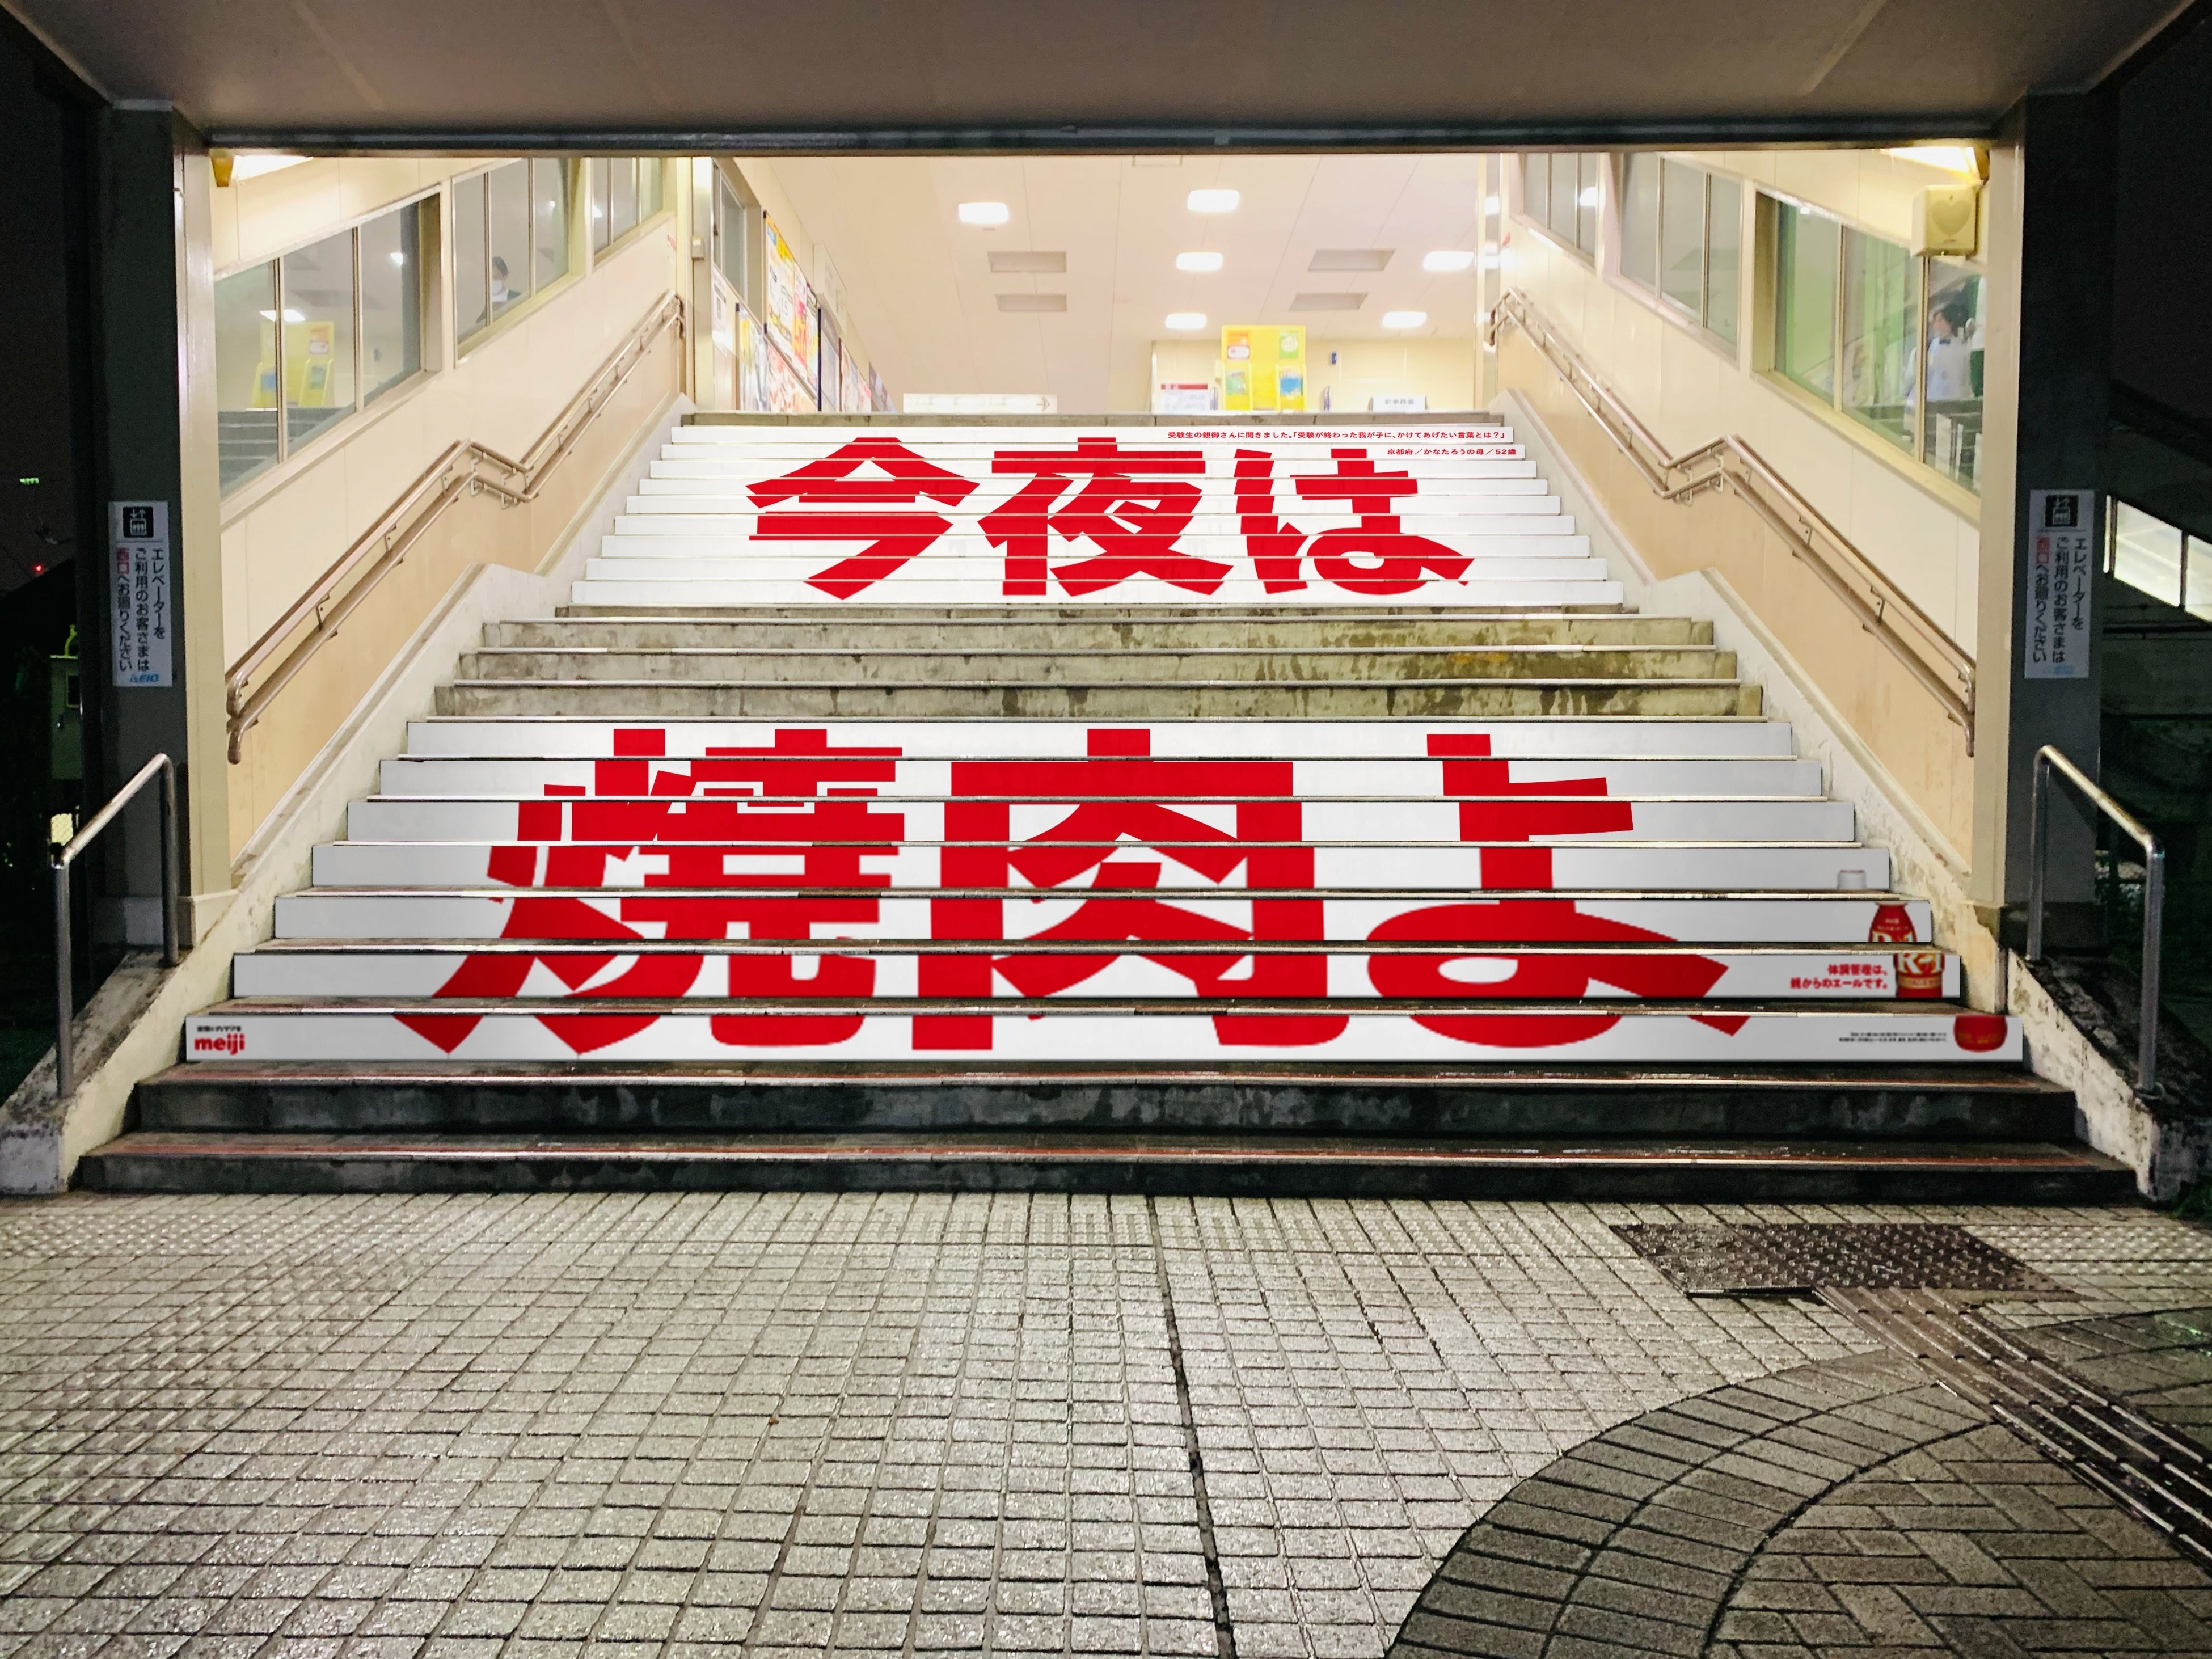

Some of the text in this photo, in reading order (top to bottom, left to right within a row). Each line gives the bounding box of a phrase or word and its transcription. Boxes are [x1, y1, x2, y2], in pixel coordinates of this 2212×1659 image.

[745, 437, 1474, 600] 今夜は
[135, 547, 150, 672] ご利用のお客さまは
[151, 548, 166, 640] エレベーターを
[2052, 537, 2069, 664] ご利用のお客さまは
[2072, 539, 2087, 631] エレベーターを
[392, 728, 1750, 1054] 焼肉よ
[194, 1033, 245, 1056] meiji
